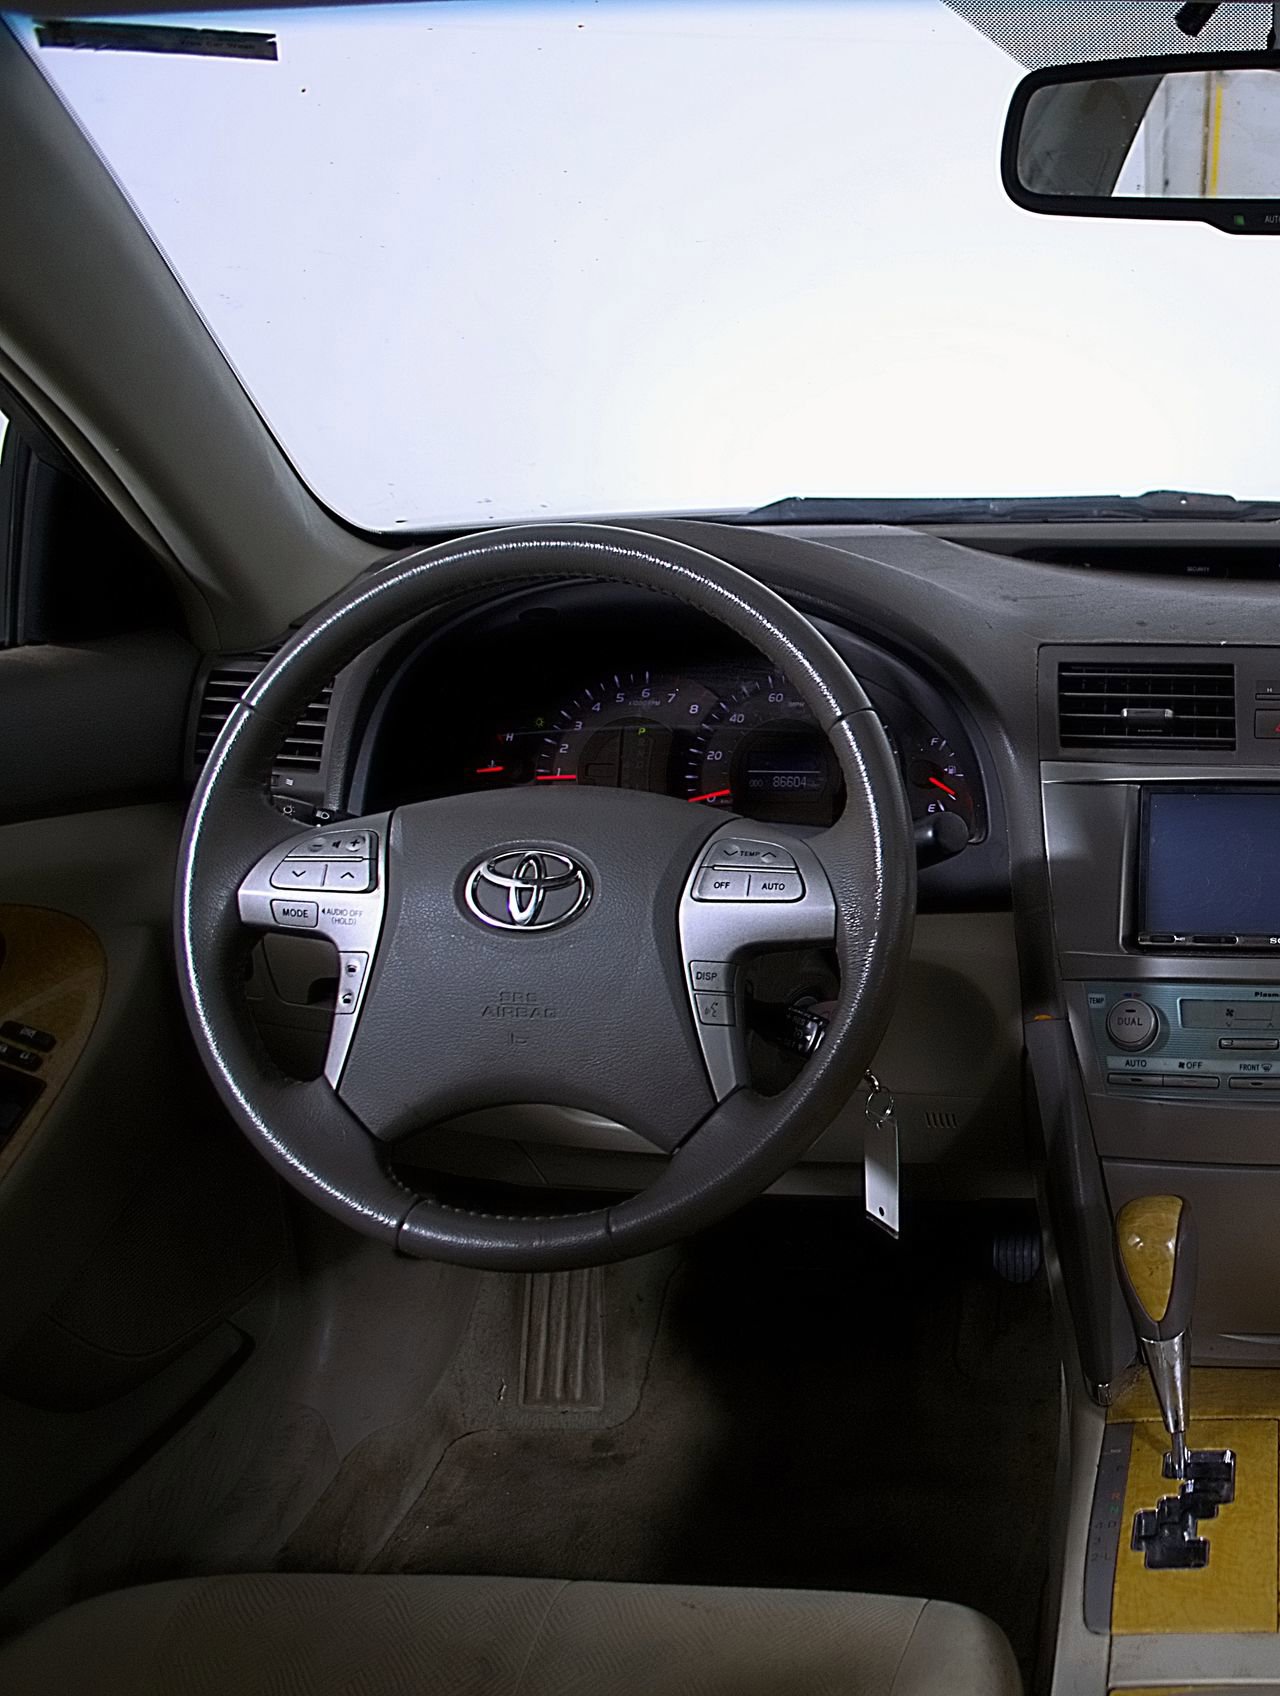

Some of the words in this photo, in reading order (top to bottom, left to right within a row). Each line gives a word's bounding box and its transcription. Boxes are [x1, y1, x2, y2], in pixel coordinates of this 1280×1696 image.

[641, 688, 651, 698] 6
[616, 693, 625, 703] 5
[668, 693, 677, 703] 7
[768, 693, 784, 703] 60
[592, 702, 602, 712] 4
[689, 704, 699, 714] 8
[729, 713, 745, 723] 40
[574, 721, 583, 731] 3
[637, 727, 647, 735] P
[505, 733, 515, 742] H
[930, 737, 939, 746] F
[560, 743, 569, 753] 2
[706, 751, 723, 760] 20
[772, 776, 807, 788] 86604
[927, 803, 936, 813] E
[761, 883, 785, 891] AUTO
[282, 908, 309, 918] MODE
[331, 917, 357, 925] (HOLD)
[696, 971, 717, 980] DISP
[1089, 997, 1104, 1005] TEMP
[1117, 1017, 1143, 1026] DUAL
[1125, 1060, 1147, 1068] AUTO
[1186, 1062, 1203, 1070] OFF
[1239, 1064, 1259, 1072] FRONT
